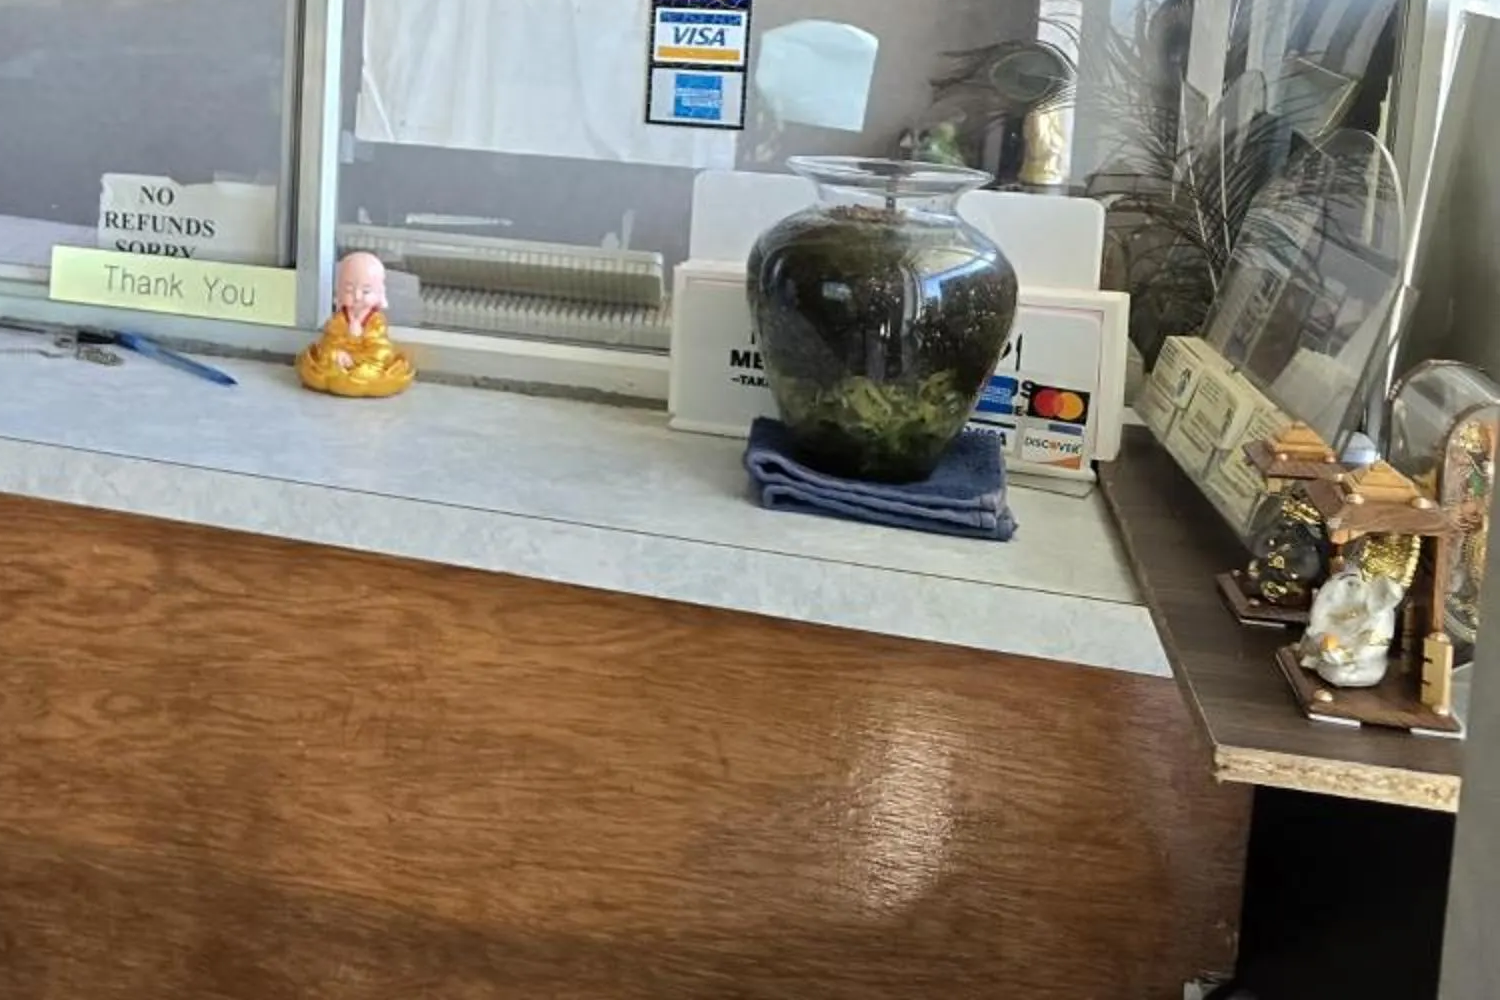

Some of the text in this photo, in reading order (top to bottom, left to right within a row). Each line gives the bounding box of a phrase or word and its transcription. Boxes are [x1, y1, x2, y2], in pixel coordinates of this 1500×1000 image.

[673, 26, 726, 47] VISA
[139, 185, 175, 206] NO
[105, 211, 216, 237] REFUNDS
[104, 264, 256, 307] Thank You
